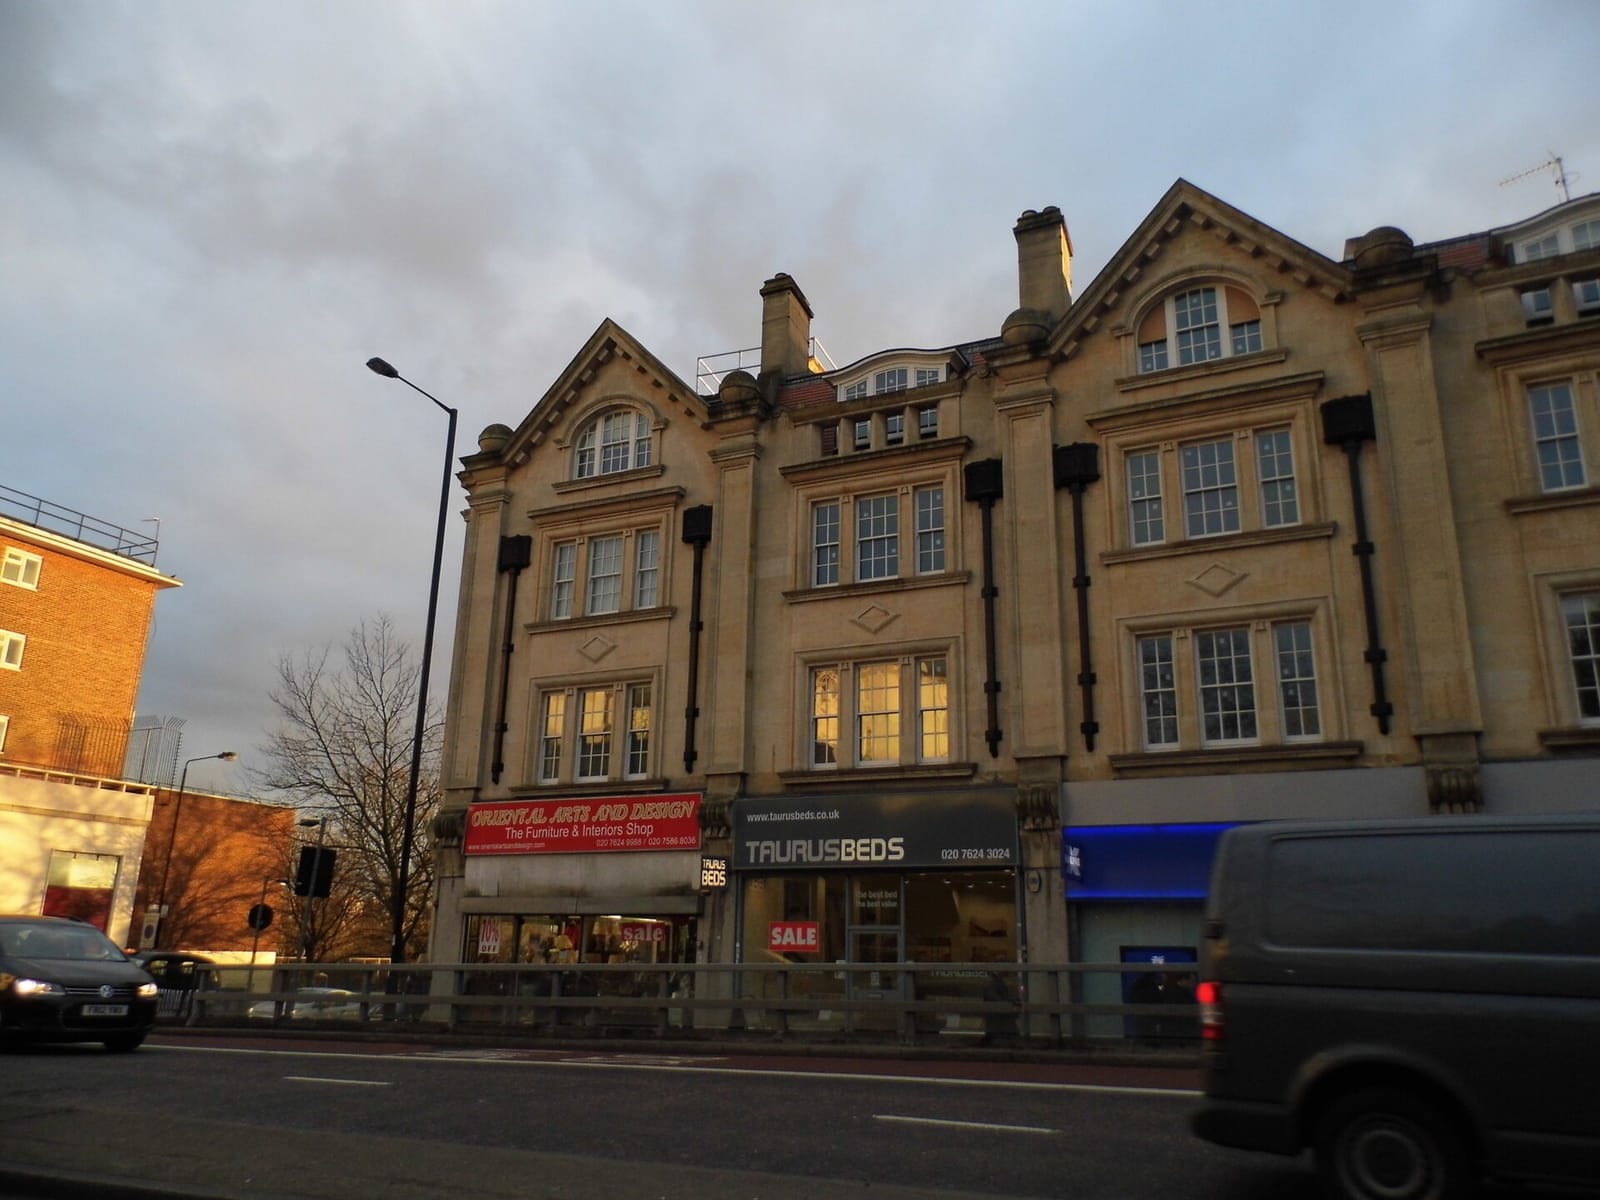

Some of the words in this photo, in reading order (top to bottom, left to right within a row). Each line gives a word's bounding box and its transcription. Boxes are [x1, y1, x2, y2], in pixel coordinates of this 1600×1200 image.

[472, 808, 547, 827] ORIENTAL
[549, 805, 591, 824] ARTS
[592, 803, 629, 822] AND
[630, 800, 695, 820] DESIGN
[747, 809, 840, 822] www.taurusbeds.co.uk
[505, 826, 523, 840] The
[526, 825, 569, 839] Furniture
[572, 824, 579, 837] &
[582, 823, 624, 837] Interiors
[626, 822, 654, 837] Shop
[648, 837, 661, 846] 020
[745, 837, 905, 864] TAURUSBEDS
[941, 848, 959, 860] 020
[961, 848, 984, 860] 7624
[986, 848, 1010, 860] 3024
[702, 858, 726, 871] TAURUS
[701, 870, 727, 887] BEDS
[624, 924, 664, 942] sale
[771, 927, 817, 945] SALE
